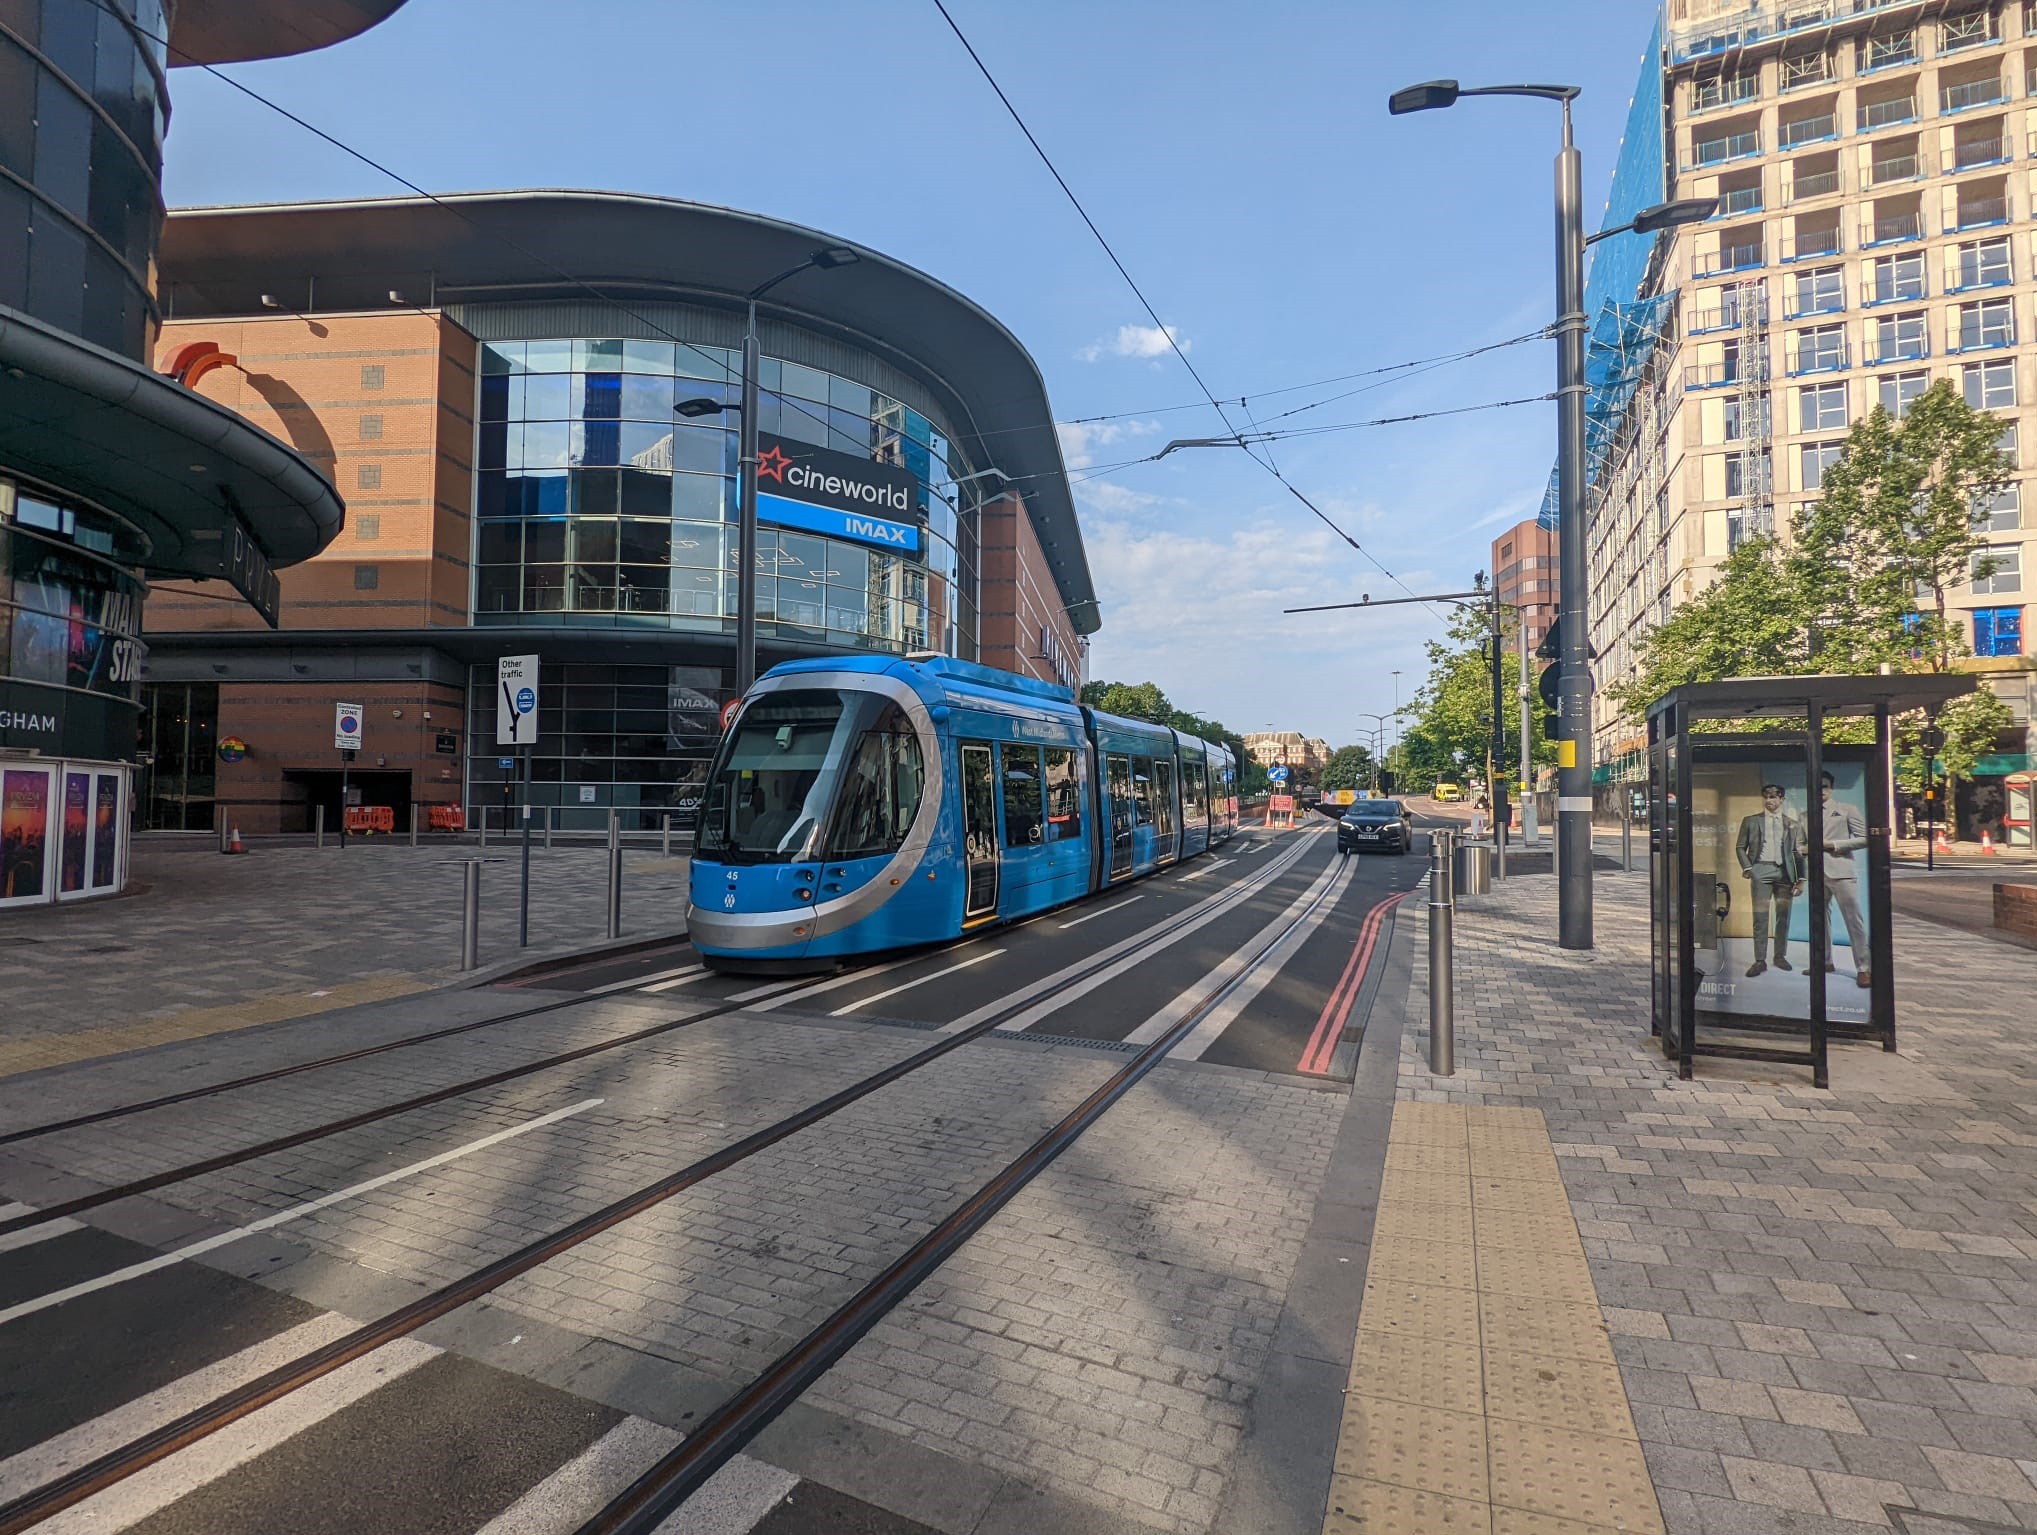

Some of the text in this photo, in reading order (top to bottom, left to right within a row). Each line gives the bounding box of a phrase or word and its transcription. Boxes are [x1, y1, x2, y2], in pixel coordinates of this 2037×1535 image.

[787, 464, 908, 511] cineworld
[846, 517, 906, 545] IMAX
[502, 660, 522, 669] Other
[501, 670, 523, 679] traffic
[673, 698, 715, 709] IMAX
[726, 871, 739, 881] 45
[1700, 981, 1737, 996] DIRECT
